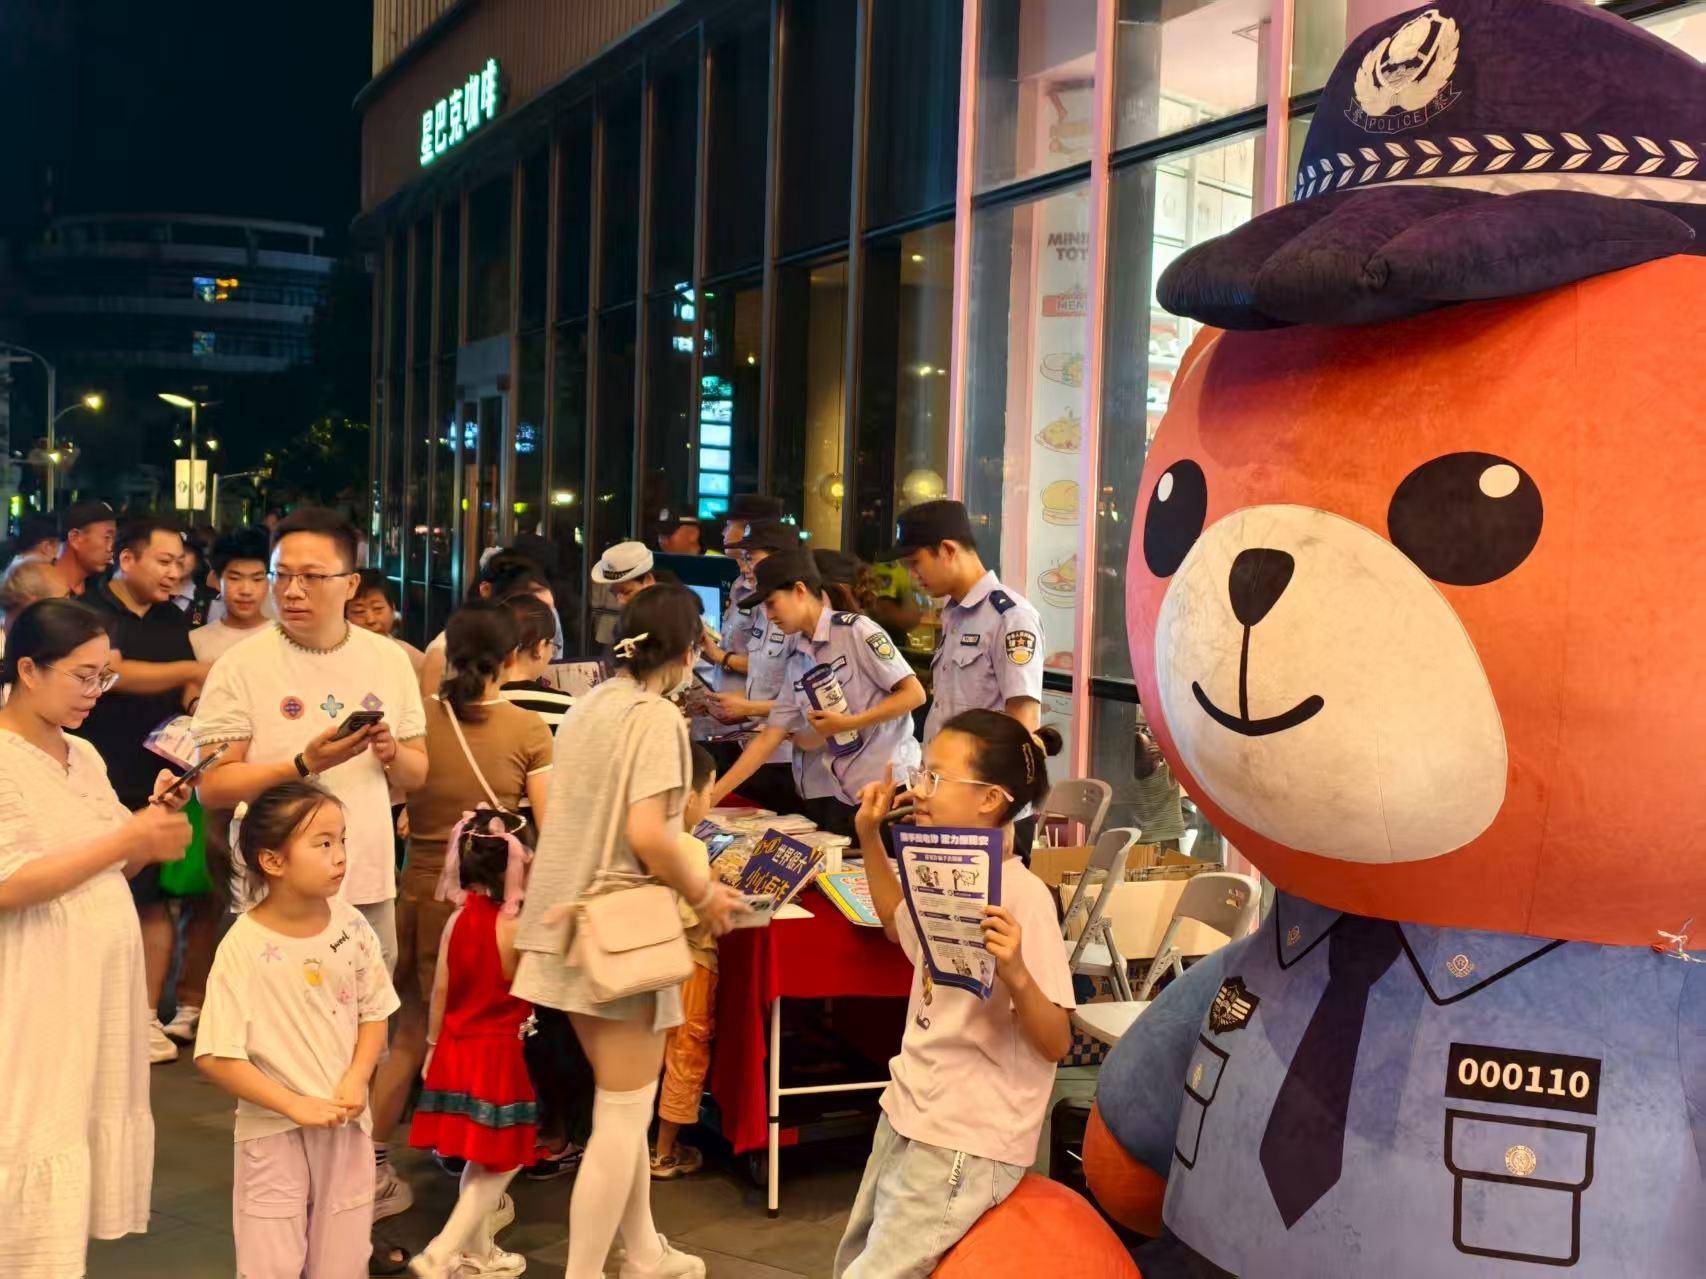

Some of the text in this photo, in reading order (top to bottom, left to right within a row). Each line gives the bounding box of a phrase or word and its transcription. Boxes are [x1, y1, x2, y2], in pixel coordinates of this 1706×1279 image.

[420, 57, 498, 167] 星巴克咖啡
[1368, 110, 1422, 131] POLICE
[1057, 299, 1088, 311] MEN
[771, 843, 808, 875] 世界很大
[1458, 1057, 1590, 1099] 000110
